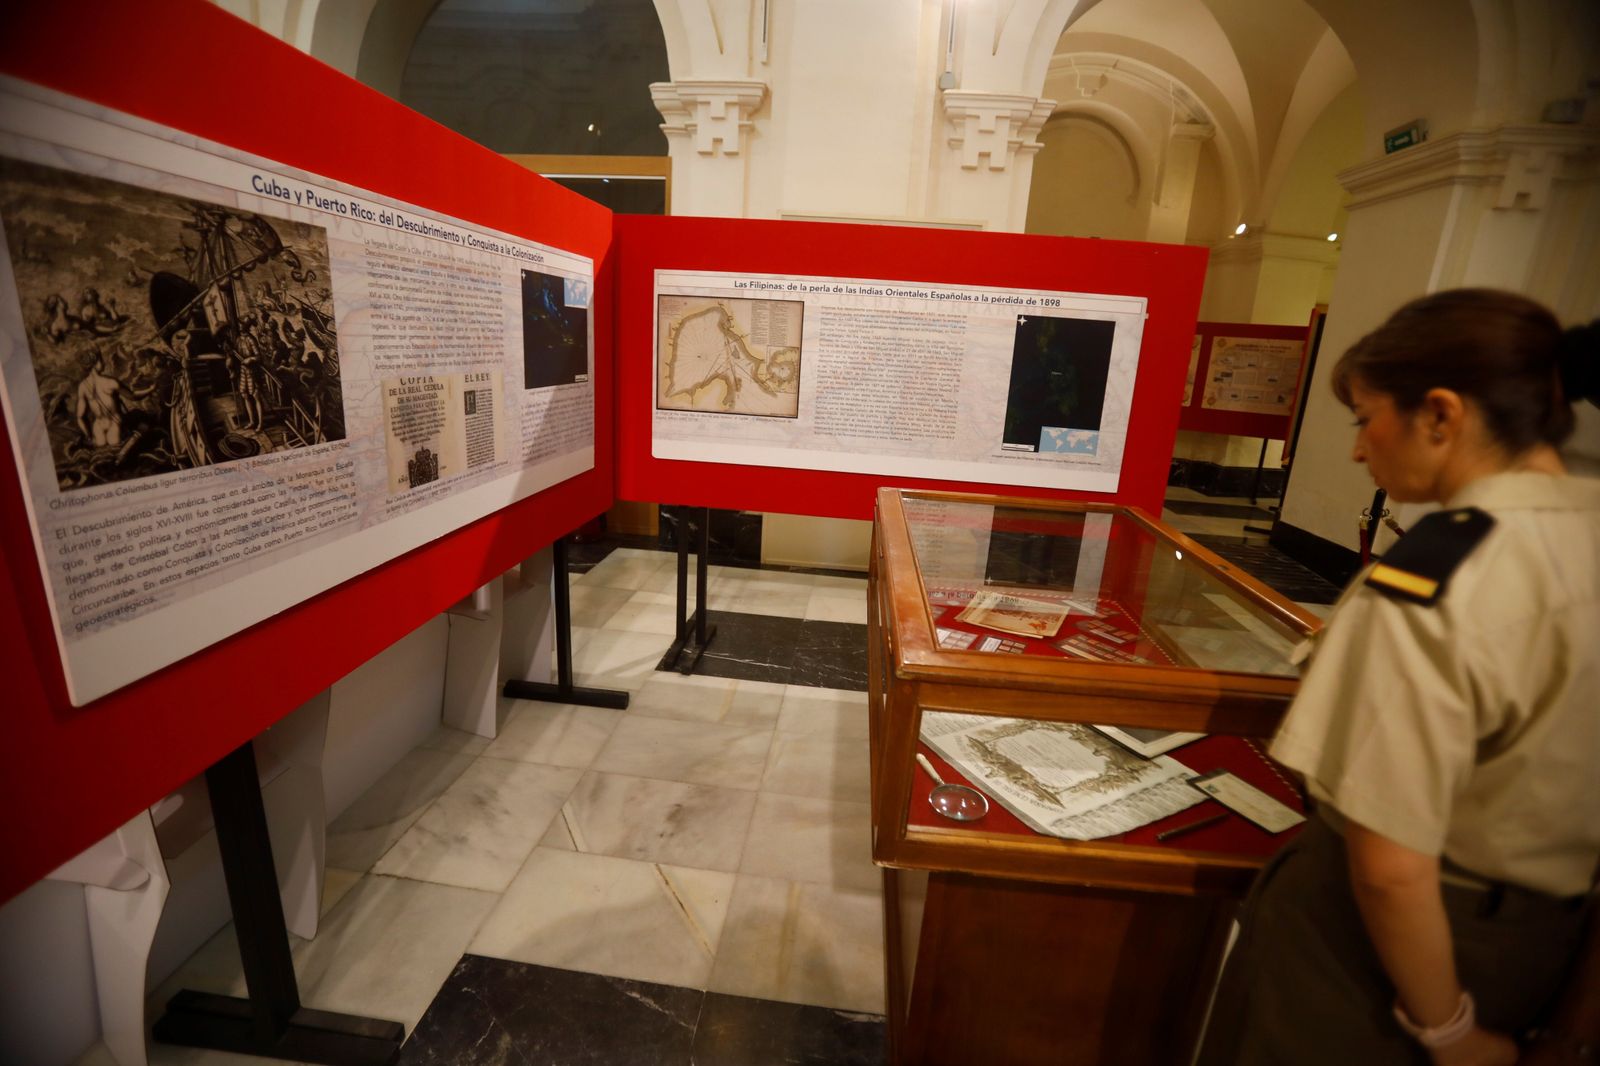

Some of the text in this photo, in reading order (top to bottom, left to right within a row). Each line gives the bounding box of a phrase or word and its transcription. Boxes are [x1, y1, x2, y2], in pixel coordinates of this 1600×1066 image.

[251, 175, 545, 262] Cuba y Puerto Rico: del Descubrimiento y Conquista a la Colonización
[734, 280, 748, 289] Las
[750, 280, 785, 291] Filipinas:
[787, 283, 798, 291] de
[799, 283, 807, 292] la
[809, 284, 831, 293] perla
[833, 285, 843, 294] de
[846, 286, 857, 295] las
[859, 287, 883, 296] Indias
[885, 288, 928, 298] Orientales
[931, 290, 972, 302] Españolas
[981, 294, 989, 302] la
[991, 294, 1023, 305] pérdida
[1026, 297, 1037, 306] de
[1040, 298, 1061, 307] 1898
[55, 528, 67, 540] El
[72, 509, 152, 536] Descubrimiento
[156, 504, 168, 516] de
[172, 496, 208, 511] América,
[211, 492, 226, 503] que
[229, 489, 239, 497] en
[242, 484, 249, 494] el
[115, 482, 158, 497] Columbus
[58, 537, 102, 556] durante
[106, 531, 121, 543] los
[126, 524, 153, 538] siglos
[156, 514, 193, 530] XVI-XVIII
[196, 510, 209, 518] fue
[212, 497, 255, 514] considerada
[257, 492, 276, 502] como
[93, 544, 134, 564] gestado
[176, 530, 182, 542] y
[251, 505, 272, 516] desde
[65, 566, 106, 586] llegada
[110, 561, 124, 572] de
[128, 547, 169, 566] Cristóbal
[172, 538, 198, 552] Colón
[68, 572, 134, 602] denominado
[136, 564, 162, 579] como
[164, 548, 206, 570] Conquista
[260, 529, 270, 538] de
[144, 580, 156, 592] En
[159, 572, 182, 586] estos
[185, 560, 220, 578] espacios
[222, 551, 241, 564] tanto
[244, 544, 262, 556] Cuba
